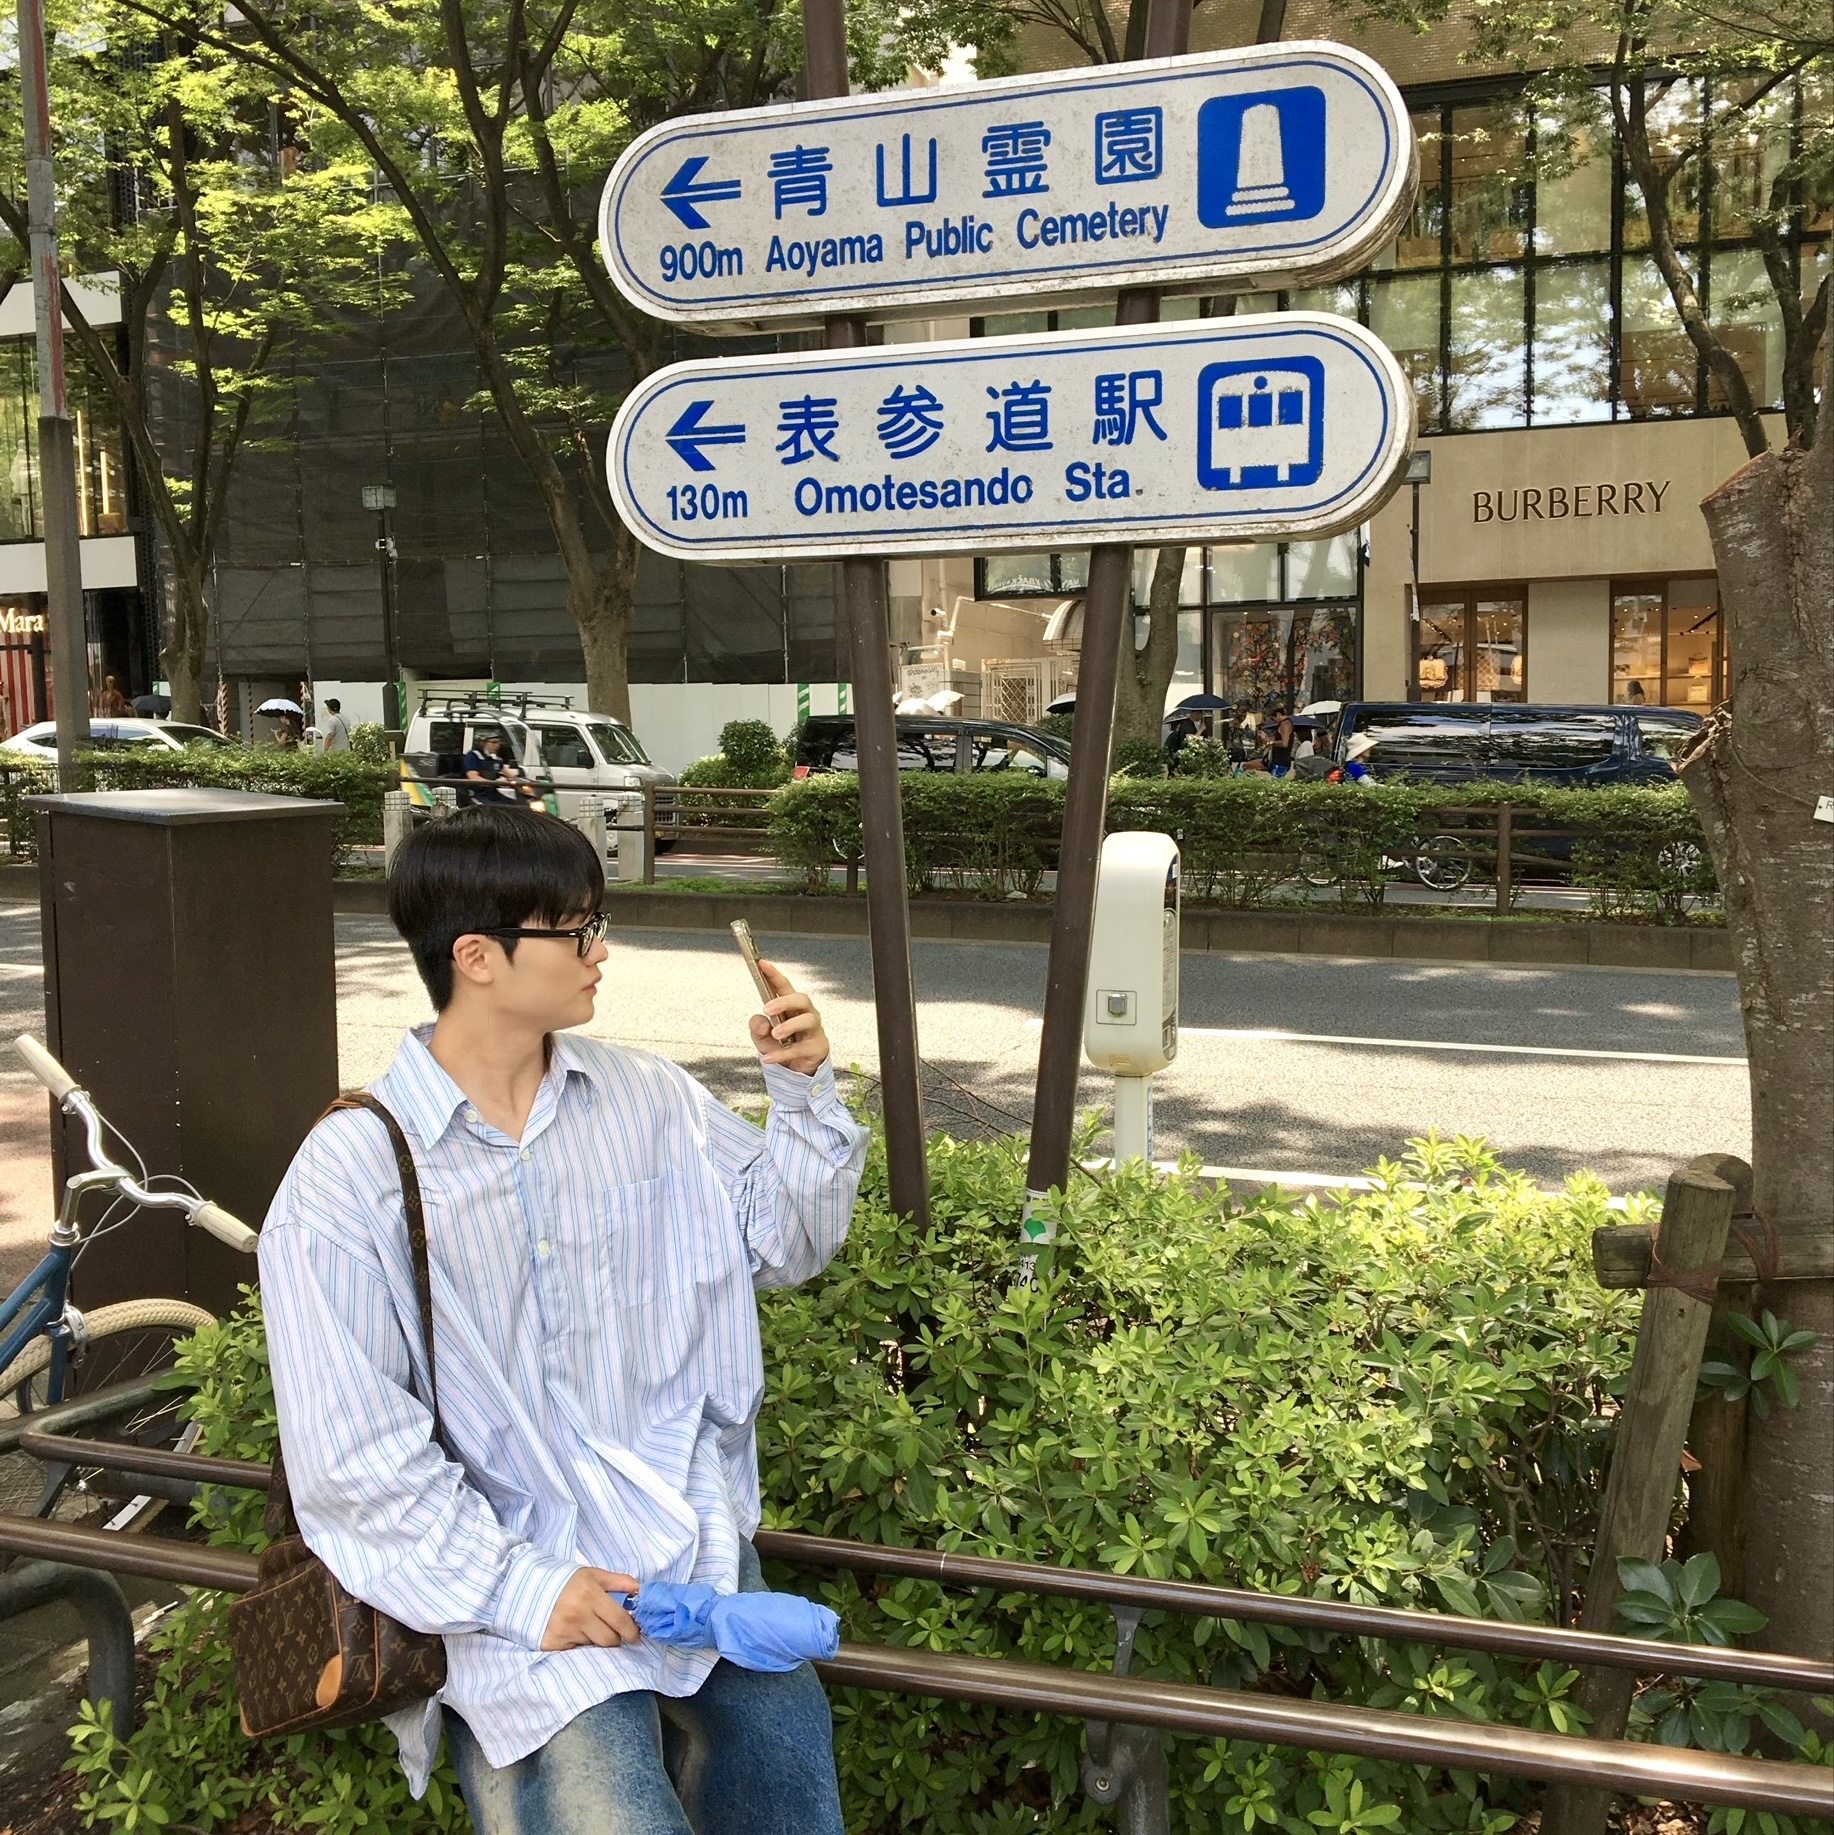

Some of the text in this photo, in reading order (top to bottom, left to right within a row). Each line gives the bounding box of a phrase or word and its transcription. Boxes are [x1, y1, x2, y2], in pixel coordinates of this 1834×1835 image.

[767, 106, 1163, 220] 青山霊園
[660, 241, 743, 282] 900m
[766, 201, 1169, 277] Aoyama Public Cemetery
[775, 370, 1168, 466] 表参道駅
[666, 483, 748, 521] 130m
[794, 461, 1144, 516] Omotesando Sta.
[1473, 481, 1671, 523] BURBERRY
[0, 607, 44, 633] Mara
